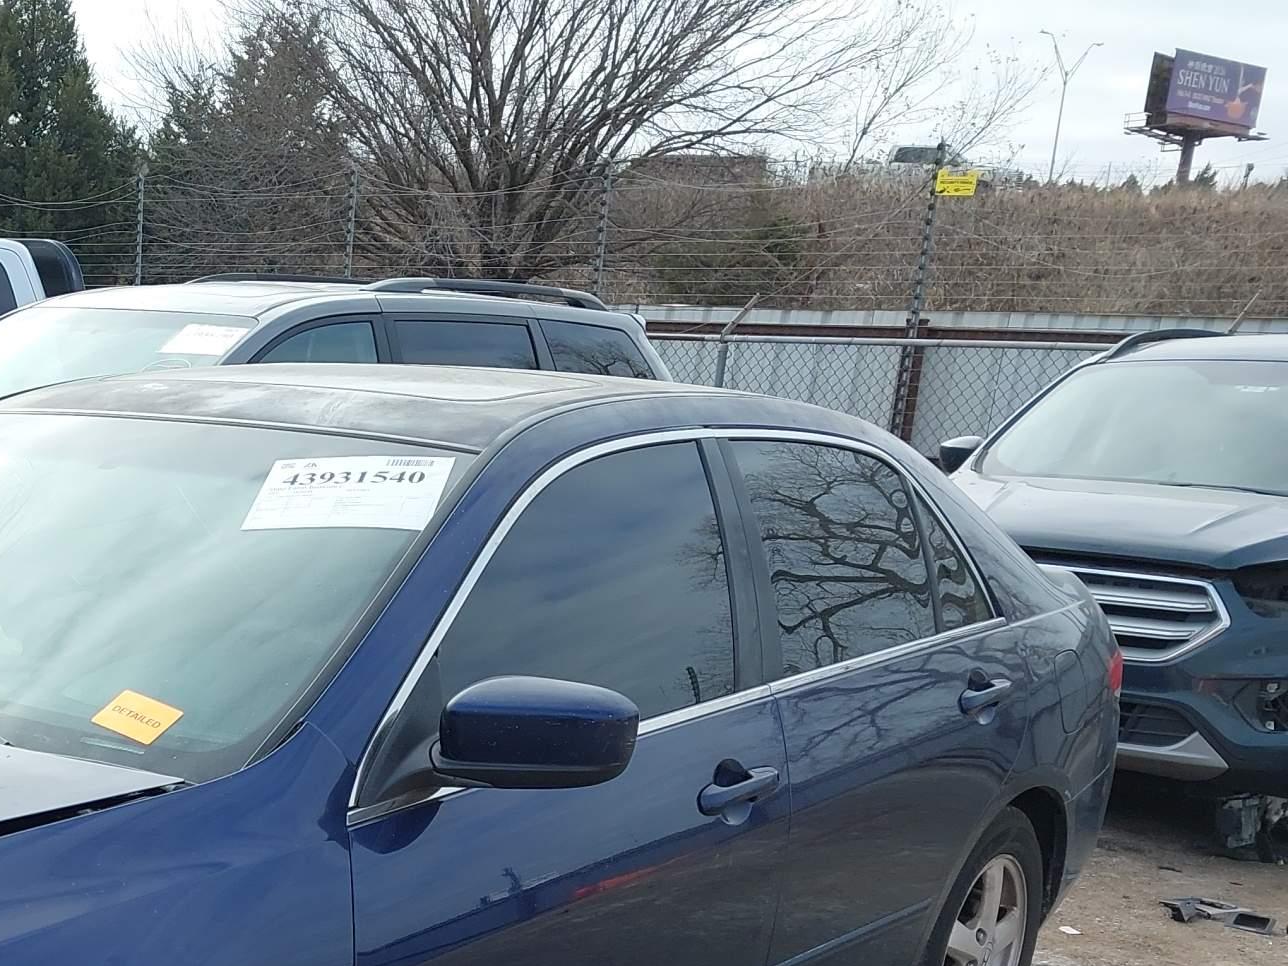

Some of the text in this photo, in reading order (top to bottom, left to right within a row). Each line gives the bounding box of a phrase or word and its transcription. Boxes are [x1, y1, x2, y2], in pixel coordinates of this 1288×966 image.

[1177, 69, 1231, 94] SHEN YUN
[282, 470, 426, 486] 43931540
[112, 705, 161, 729] DETAILED
